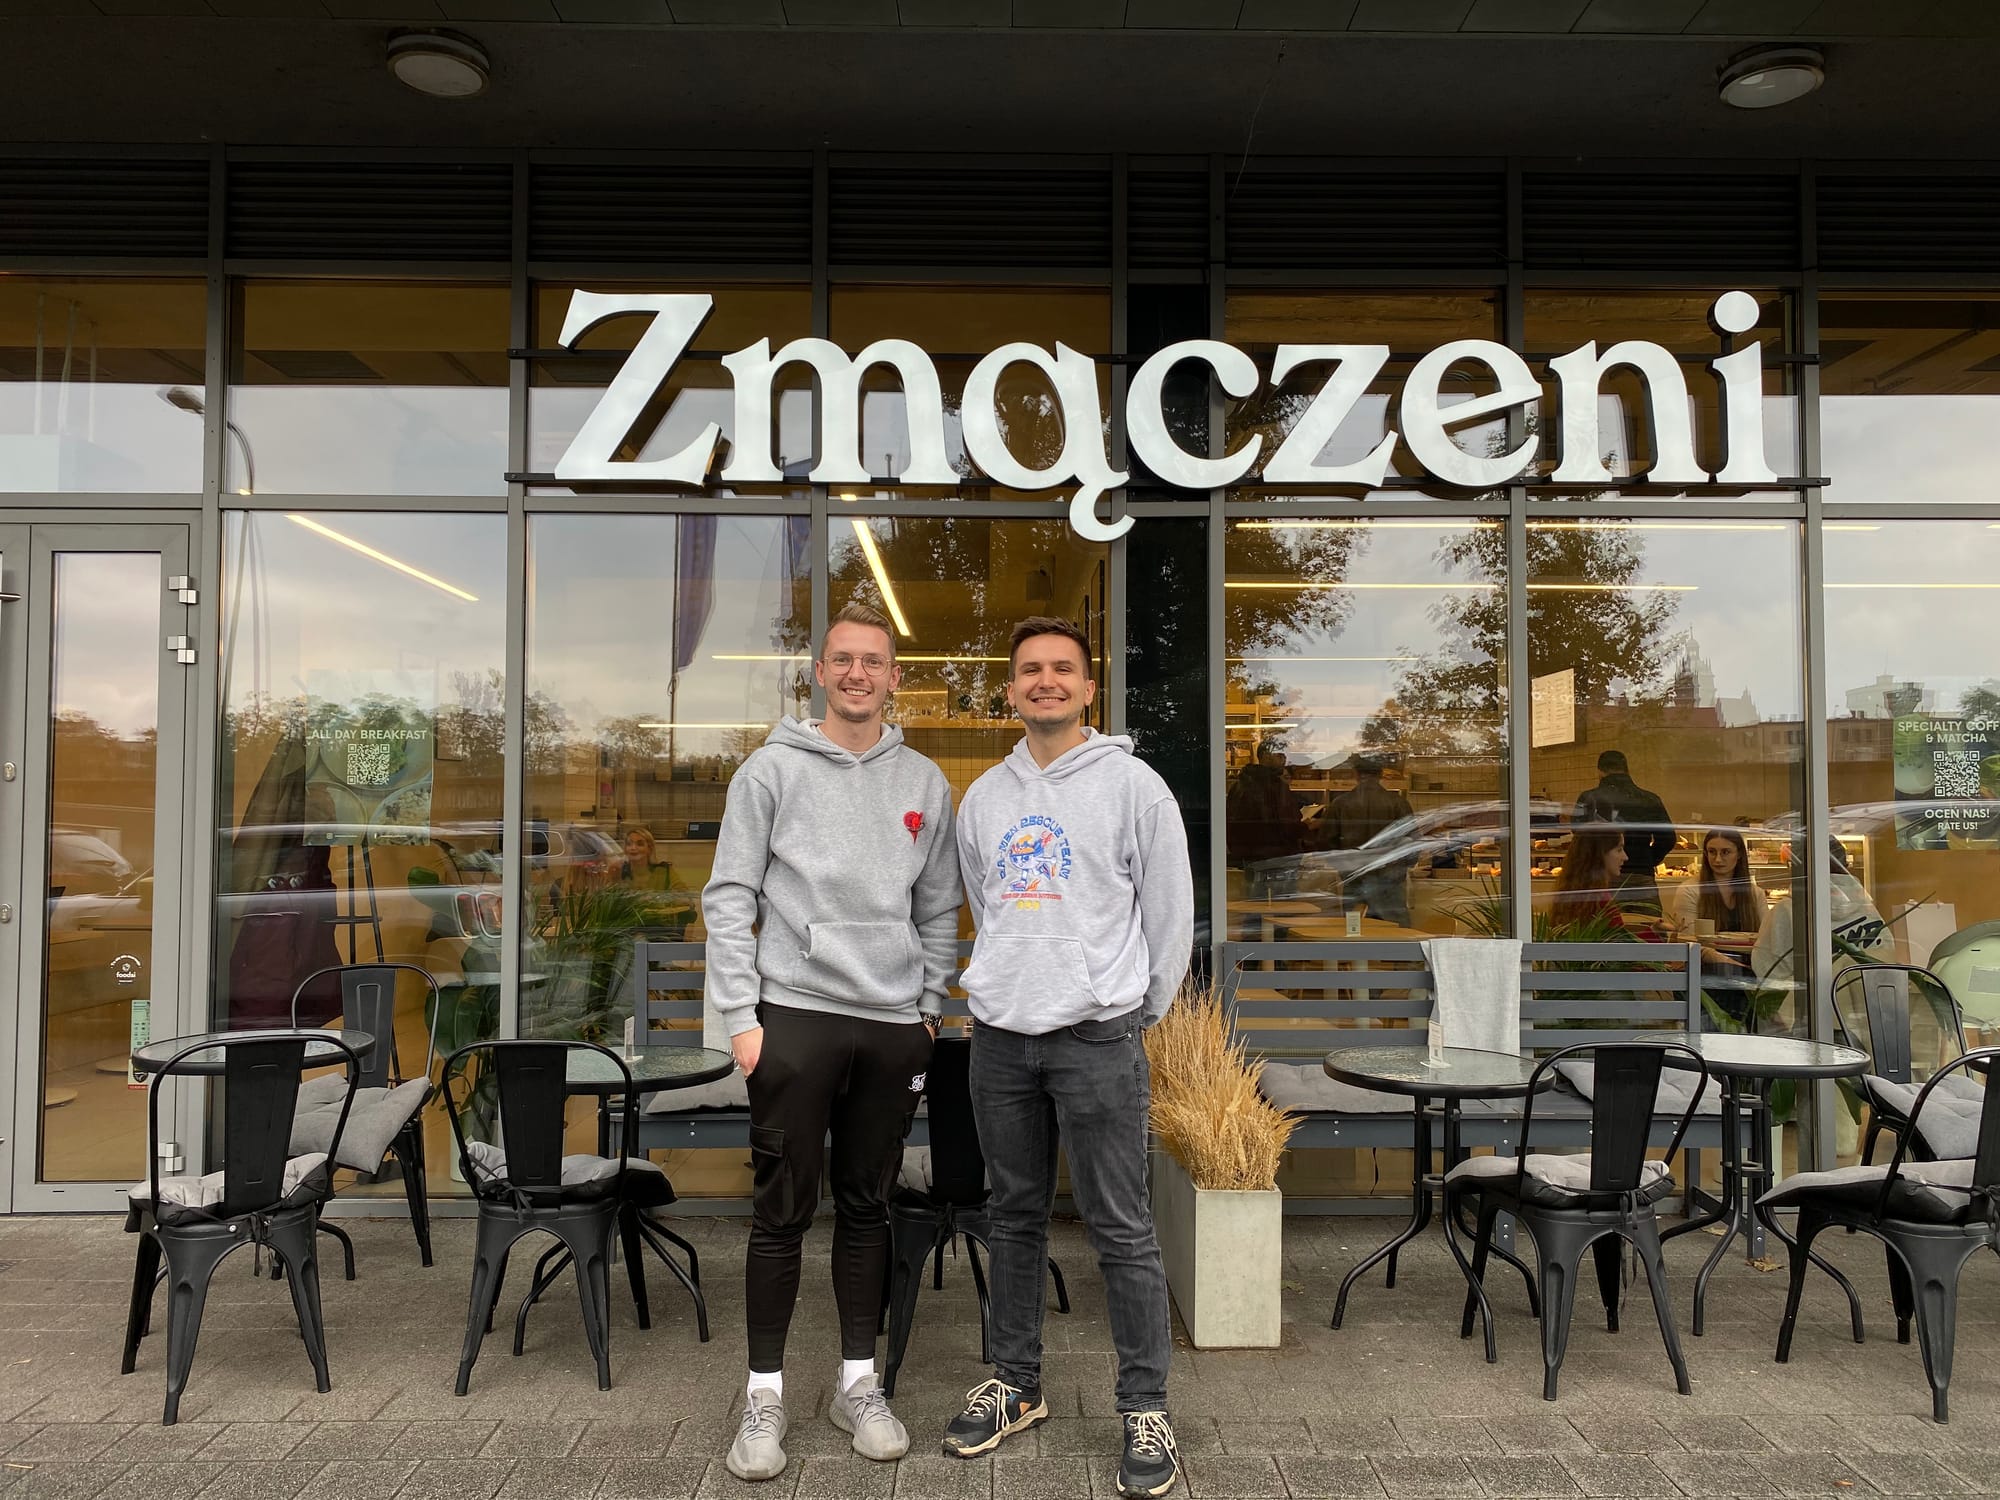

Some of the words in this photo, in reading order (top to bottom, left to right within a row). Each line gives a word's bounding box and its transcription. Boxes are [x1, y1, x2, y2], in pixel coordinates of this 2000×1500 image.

[555, 289, 1778, 542] Zmączeni
[1898, 721, 1962, 731] SPECIALTY
[311, 730, 331, 740] ALL
[335, 730, 357, 740] DAY
[360, 730, 427, 740] BREAKFAST
[1925, 734, 1934, 743] &
[1937, 733, 1988, 743] MATCHA
[1924, 806, 1960, 819] OCEŃ
[1963, 808, 1990, 819] NAS!
[1937, 821, 1961, 830] RATE
[1963, 821, 1978, 830] US!
[1020, 815, 1064, 838] RESCUE
[1059, 838, 1072, 879] TEAM
